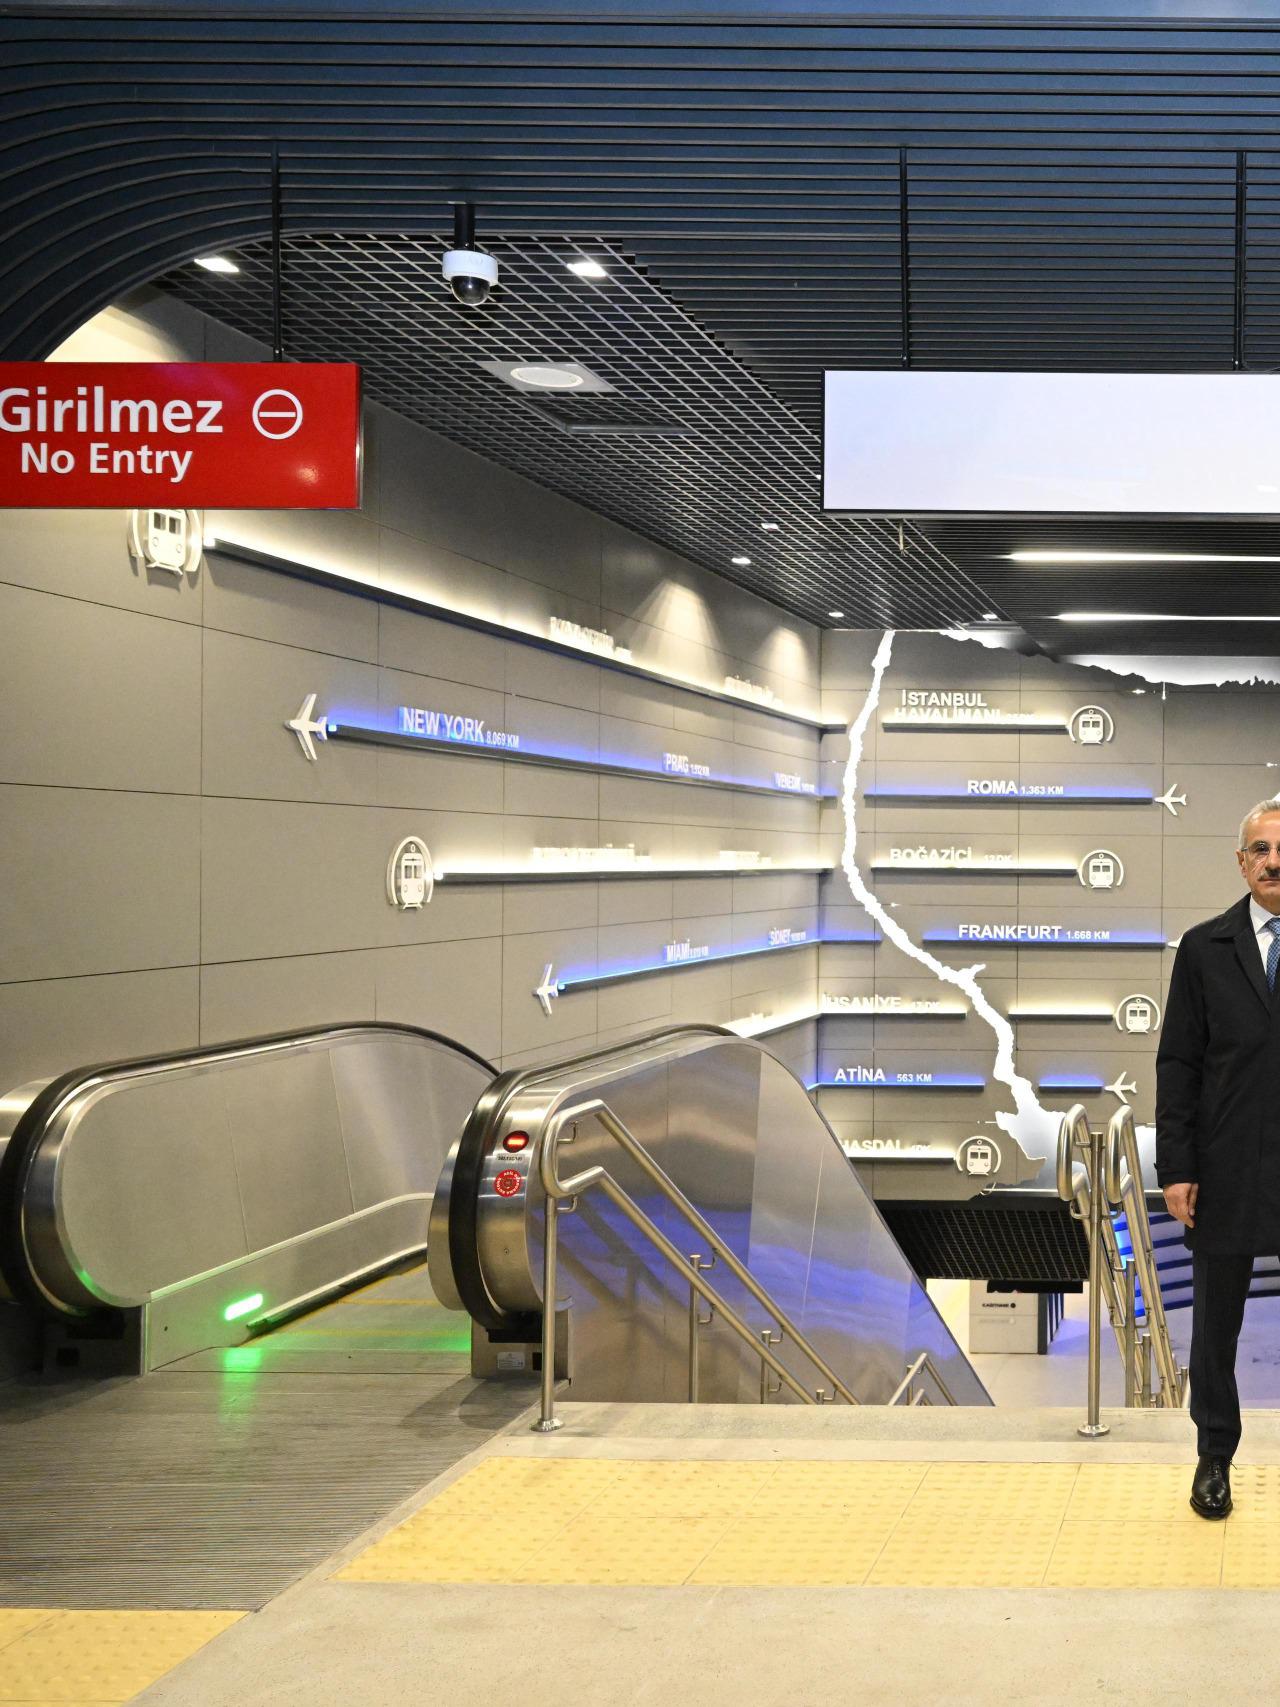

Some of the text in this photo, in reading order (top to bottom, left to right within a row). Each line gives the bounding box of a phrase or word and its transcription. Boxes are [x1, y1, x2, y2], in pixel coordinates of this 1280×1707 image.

[0, 386, 223, 433] Girilmez
[21, 442, 193, 483] No Entry
[902, 689, 987, 707] İSTANBUL
[403, 707, 440, 736] NEW
[444, 714, 485, 743] YORK
[507, 734, 519, 749] KM
[967, 780, 1018, 795] ROMA
[1047, 786, 1064, 795] KM
[958, 924, 1062, 940] FRANKFURT
[1093, 931, 1110, 940] KM
[834, 1065, 932, 1082] ATİNA 563 KM
